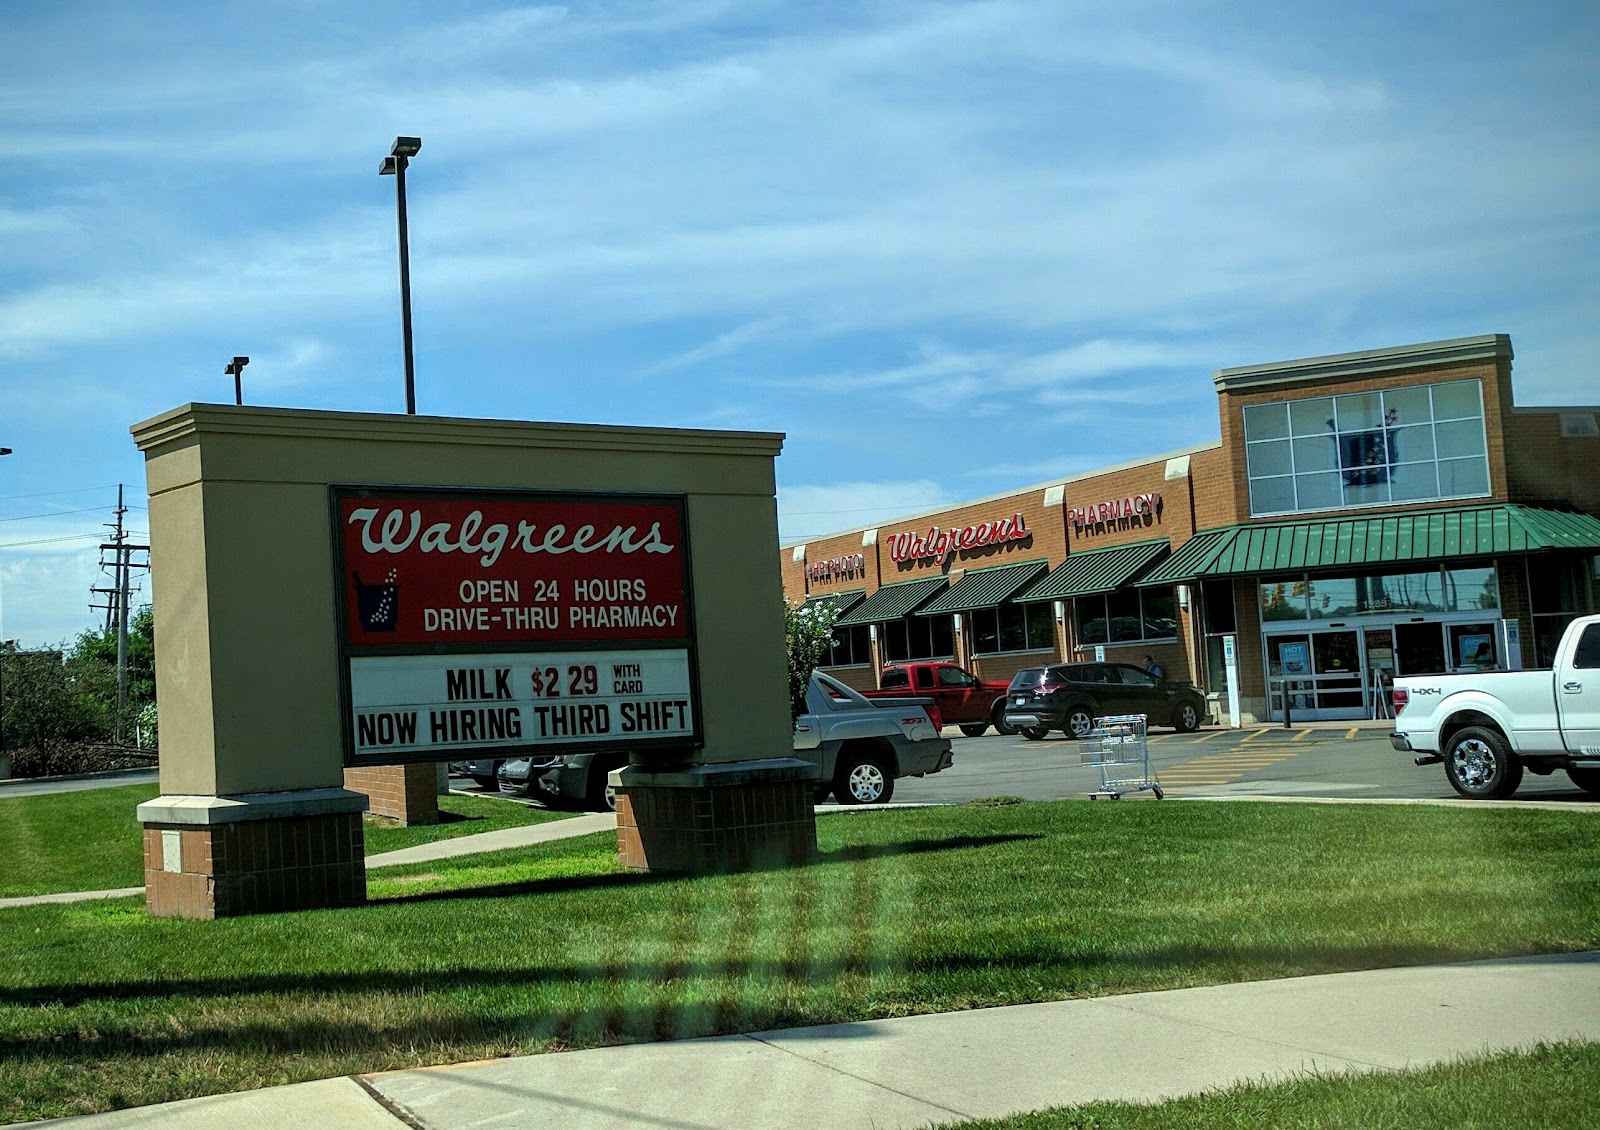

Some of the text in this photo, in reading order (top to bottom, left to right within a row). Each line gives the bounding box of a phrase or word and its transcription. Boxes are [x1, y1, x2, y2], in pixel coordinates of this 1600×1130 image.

[1067, 493, 1157, 527] PHARMACY
[349, 507, 675, 567] Walgreens
[886, 513, 1031, 566] Walgreens
[828, 553, 865, 575] PHOTO
[459, 579, 646, 603] OPEN 24 HOURS
[424, 605, 678, 632] DRIVE-THRU PHARMACY
[1284, 646, 1303, 654] HOT
[446, 668, 512, 701] MILK
[613, 664, 641, 679] WITH
[613, 680, 643, 694] CARD
[358, 700, 688, 747] NOW HIRING THIRD SHIFT
